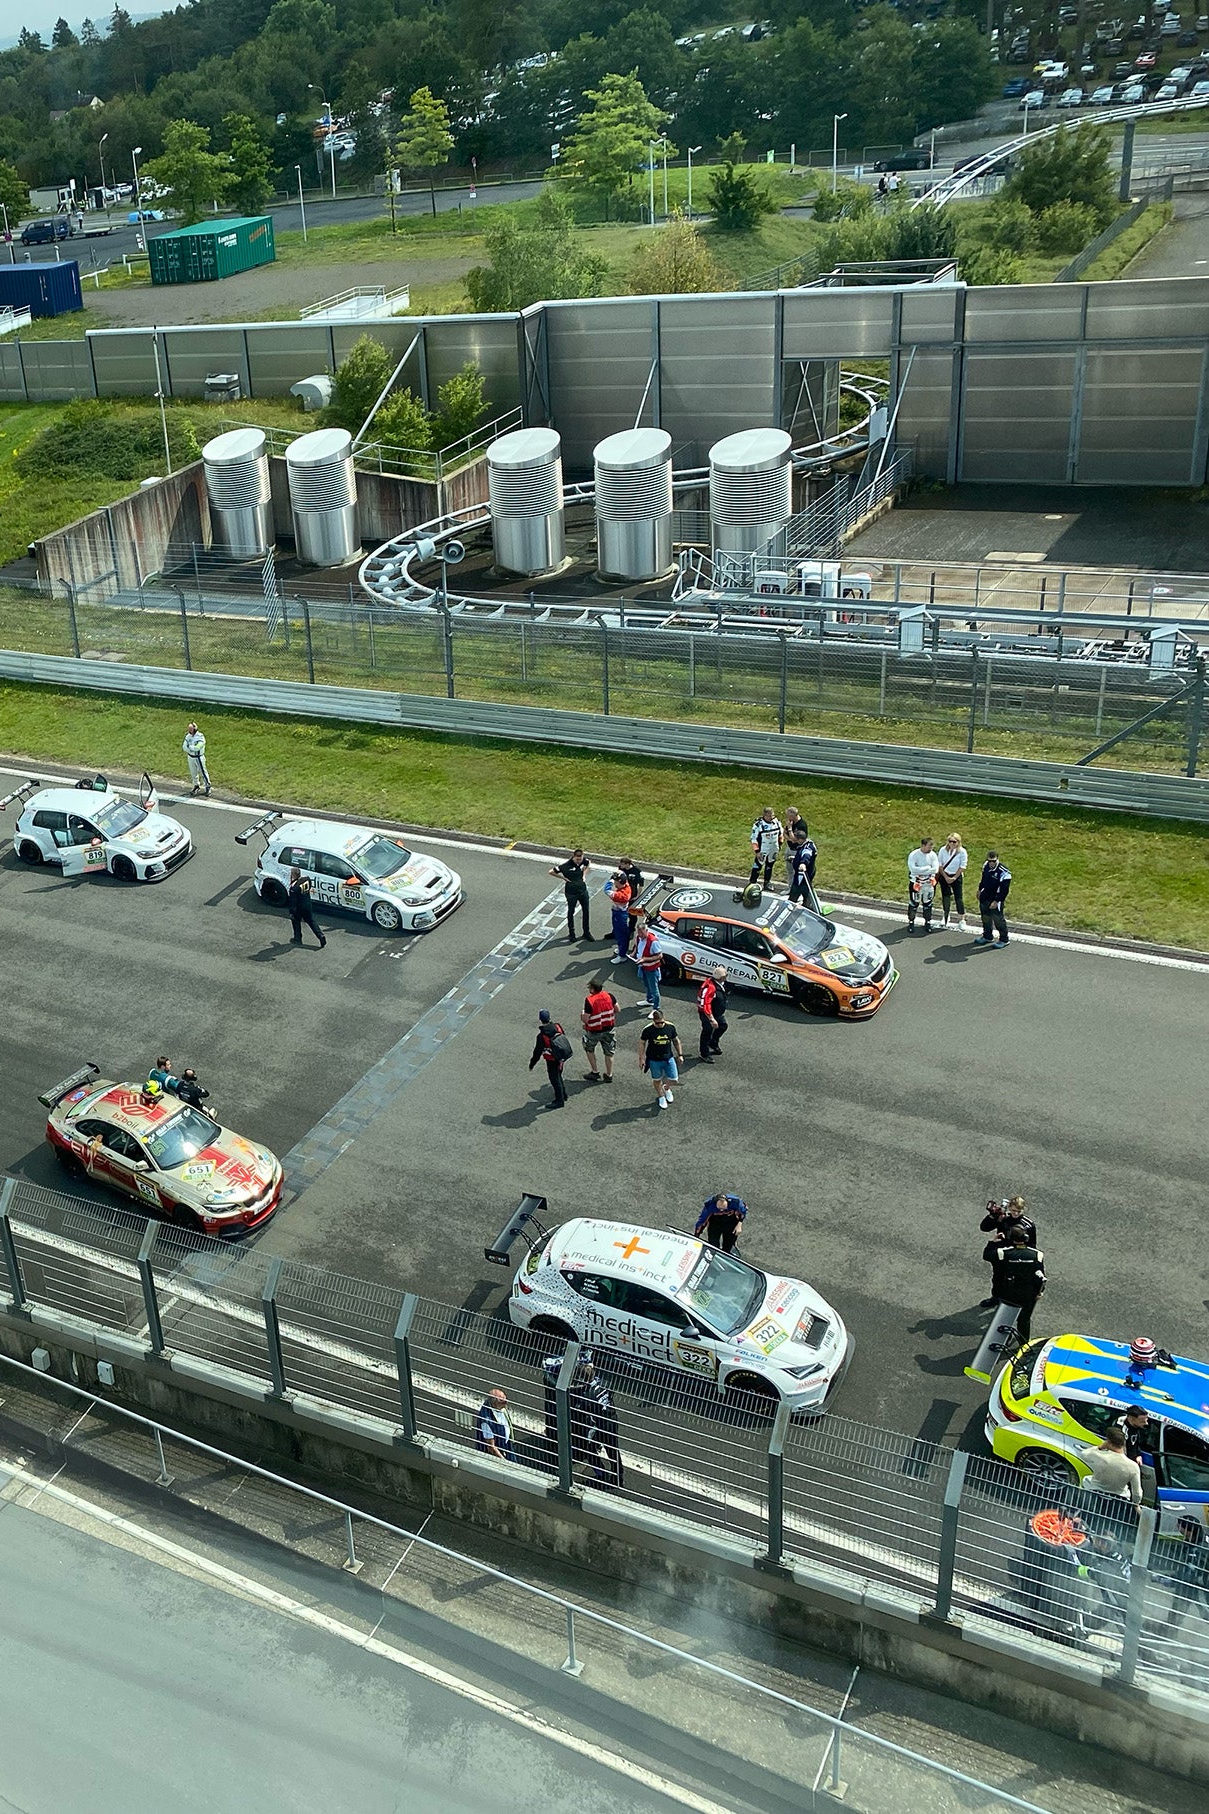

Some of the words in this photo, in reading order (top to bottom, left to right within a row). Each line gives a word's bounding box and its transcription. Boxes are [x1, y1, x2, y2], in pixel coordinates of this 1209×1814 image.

[88, 851, 103, 860] 819
[309, 876, 340, 893] dical
[344, 889, 361, 900] 800
[635, 879, 667, 909] PEUGEOT
[827, 953, 850, 963] 821
[726, 966, 758, 982] REPAR
[762, 970, 782, 983] 821
[188, 1164, 211, 1175] 651
[139, 1183, 156, 1199] 651
[571, 1251, 617, 1268] medical
[586, 1310, 671, 1348] medical
[756, 1325, 780, 1343] 322
[683, 1351, 710, 1367] 322
[735, 1349, 768, 1362] FALKEN
